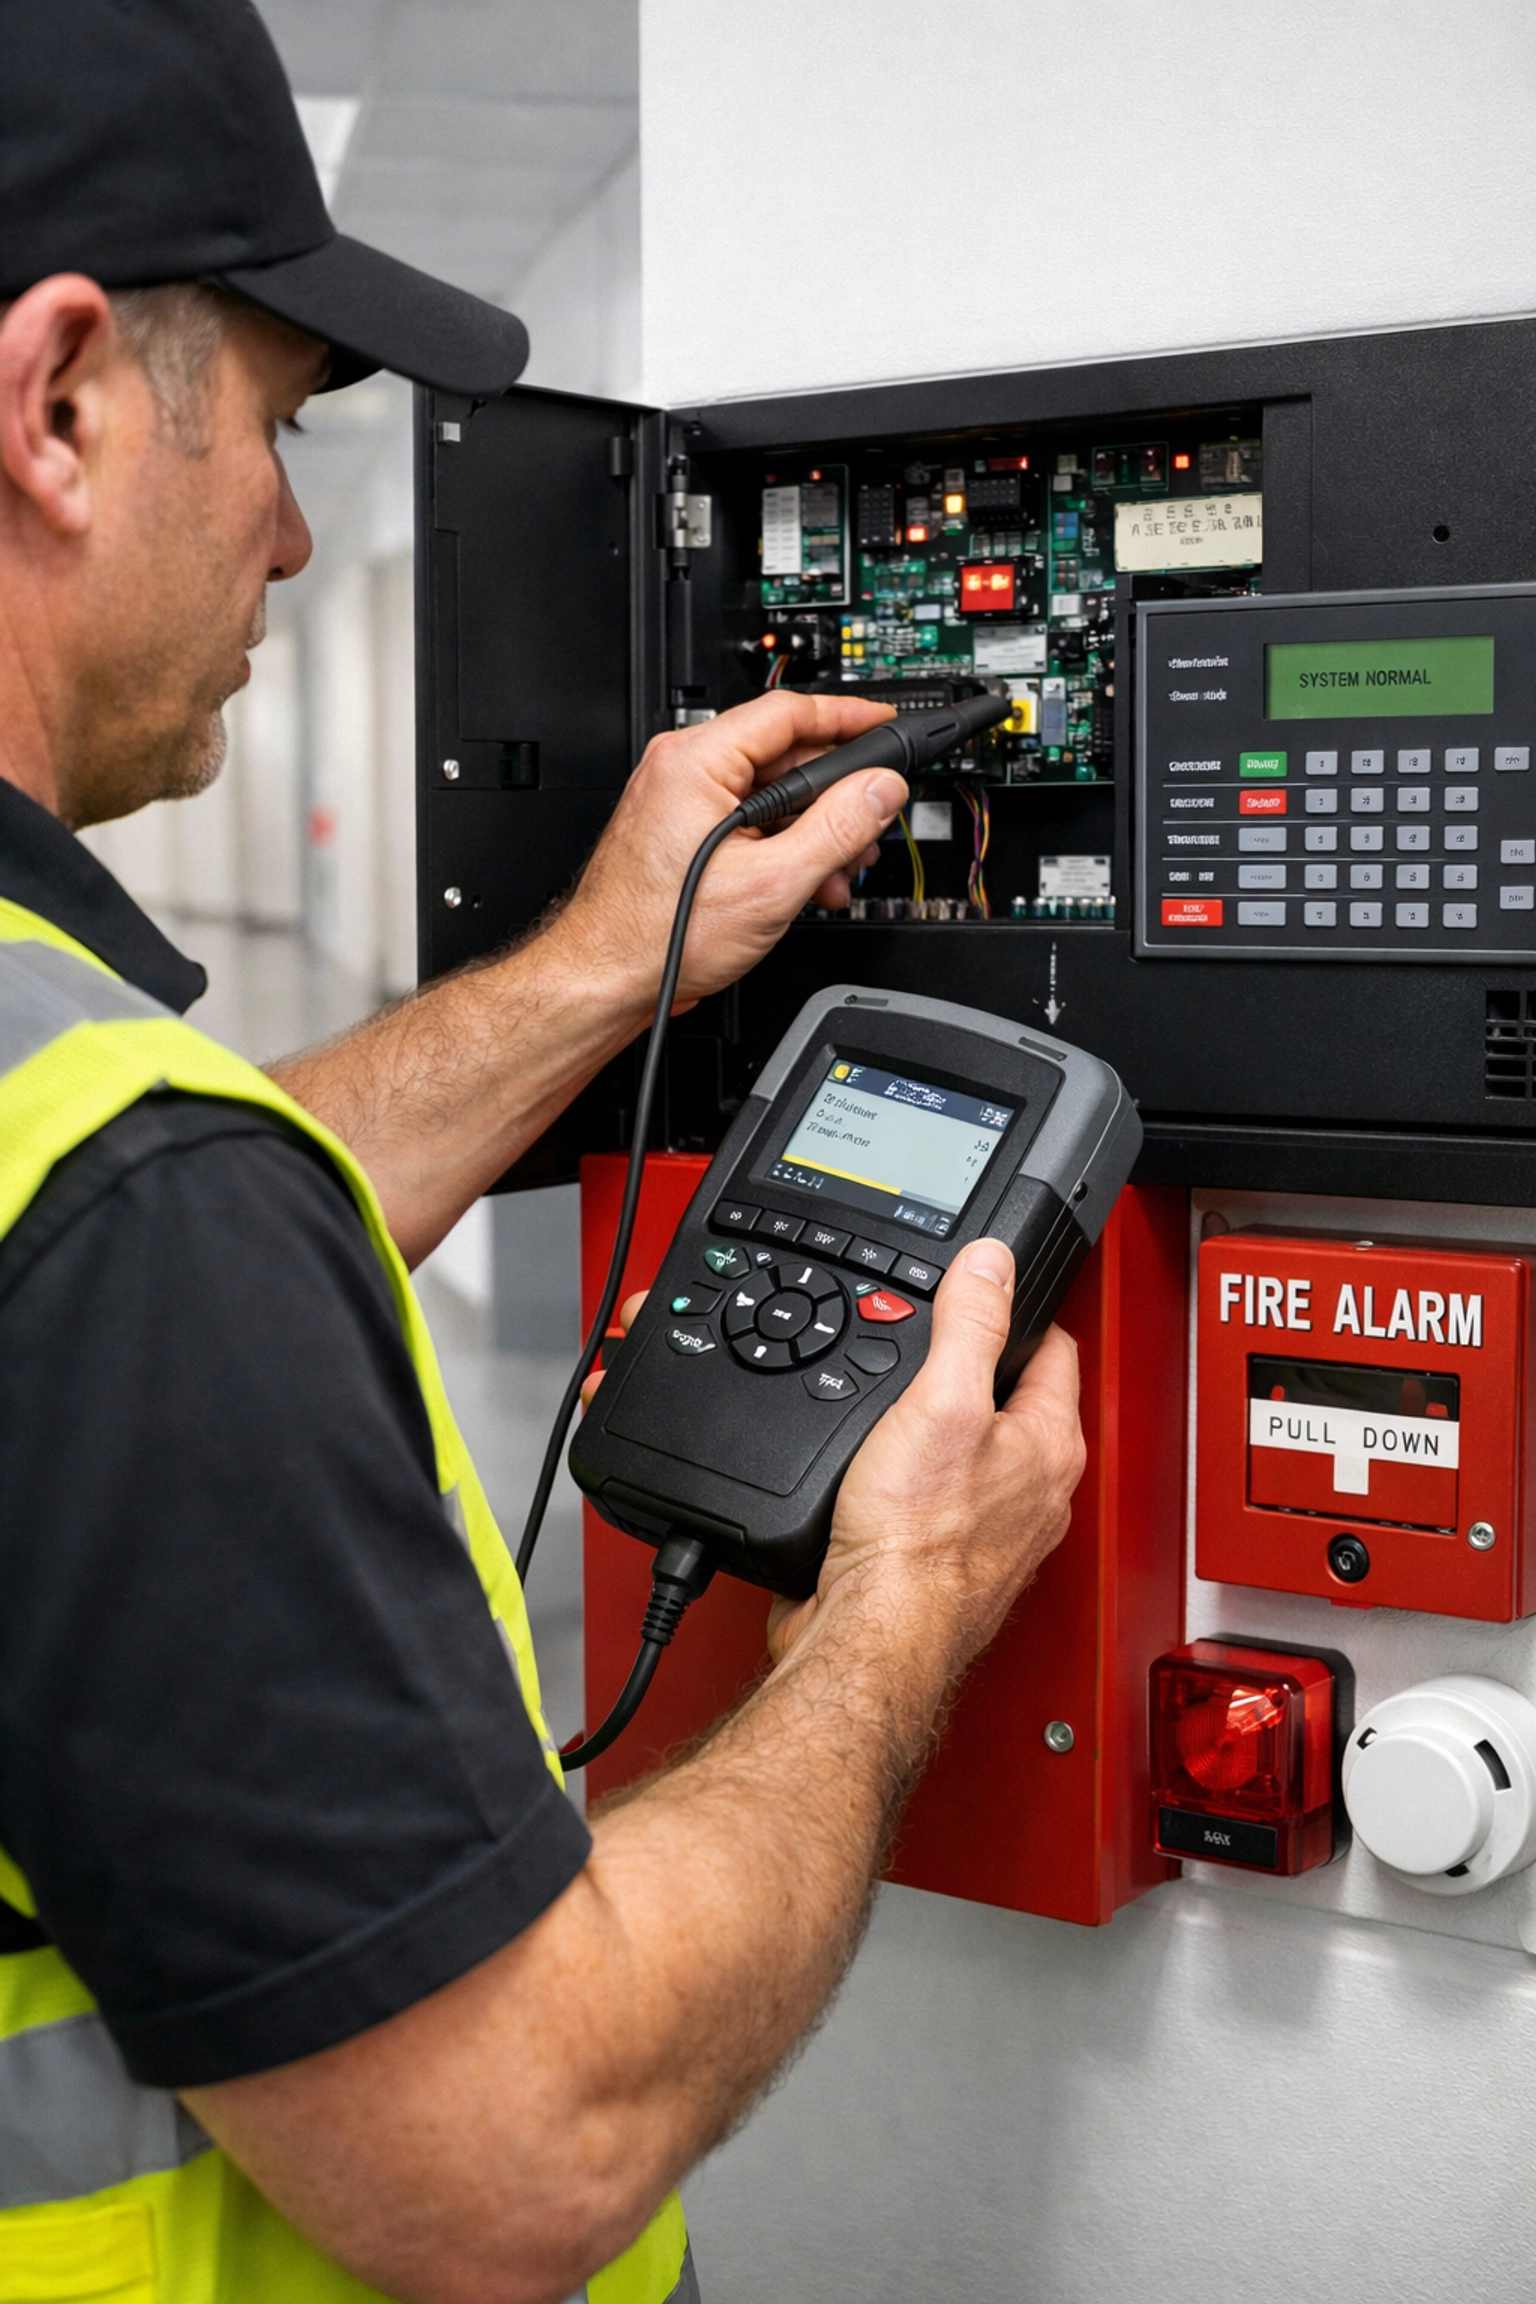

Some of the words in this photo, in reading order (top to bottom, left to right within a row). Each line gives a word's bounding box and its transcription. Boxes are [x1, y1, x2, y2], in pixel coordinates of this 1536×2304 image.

[1299, 671, 1360, 689] SYSTEM
[1365, 668, 1432, 687] NORMAL
[1219, 1273, 1312, 1331] FIRE
[1333, 1283, 1483, 1348] ALARM
[1268, 1416, 1336, 1445] PULL
[1362, 1426, 1440, 1456] DOWN
